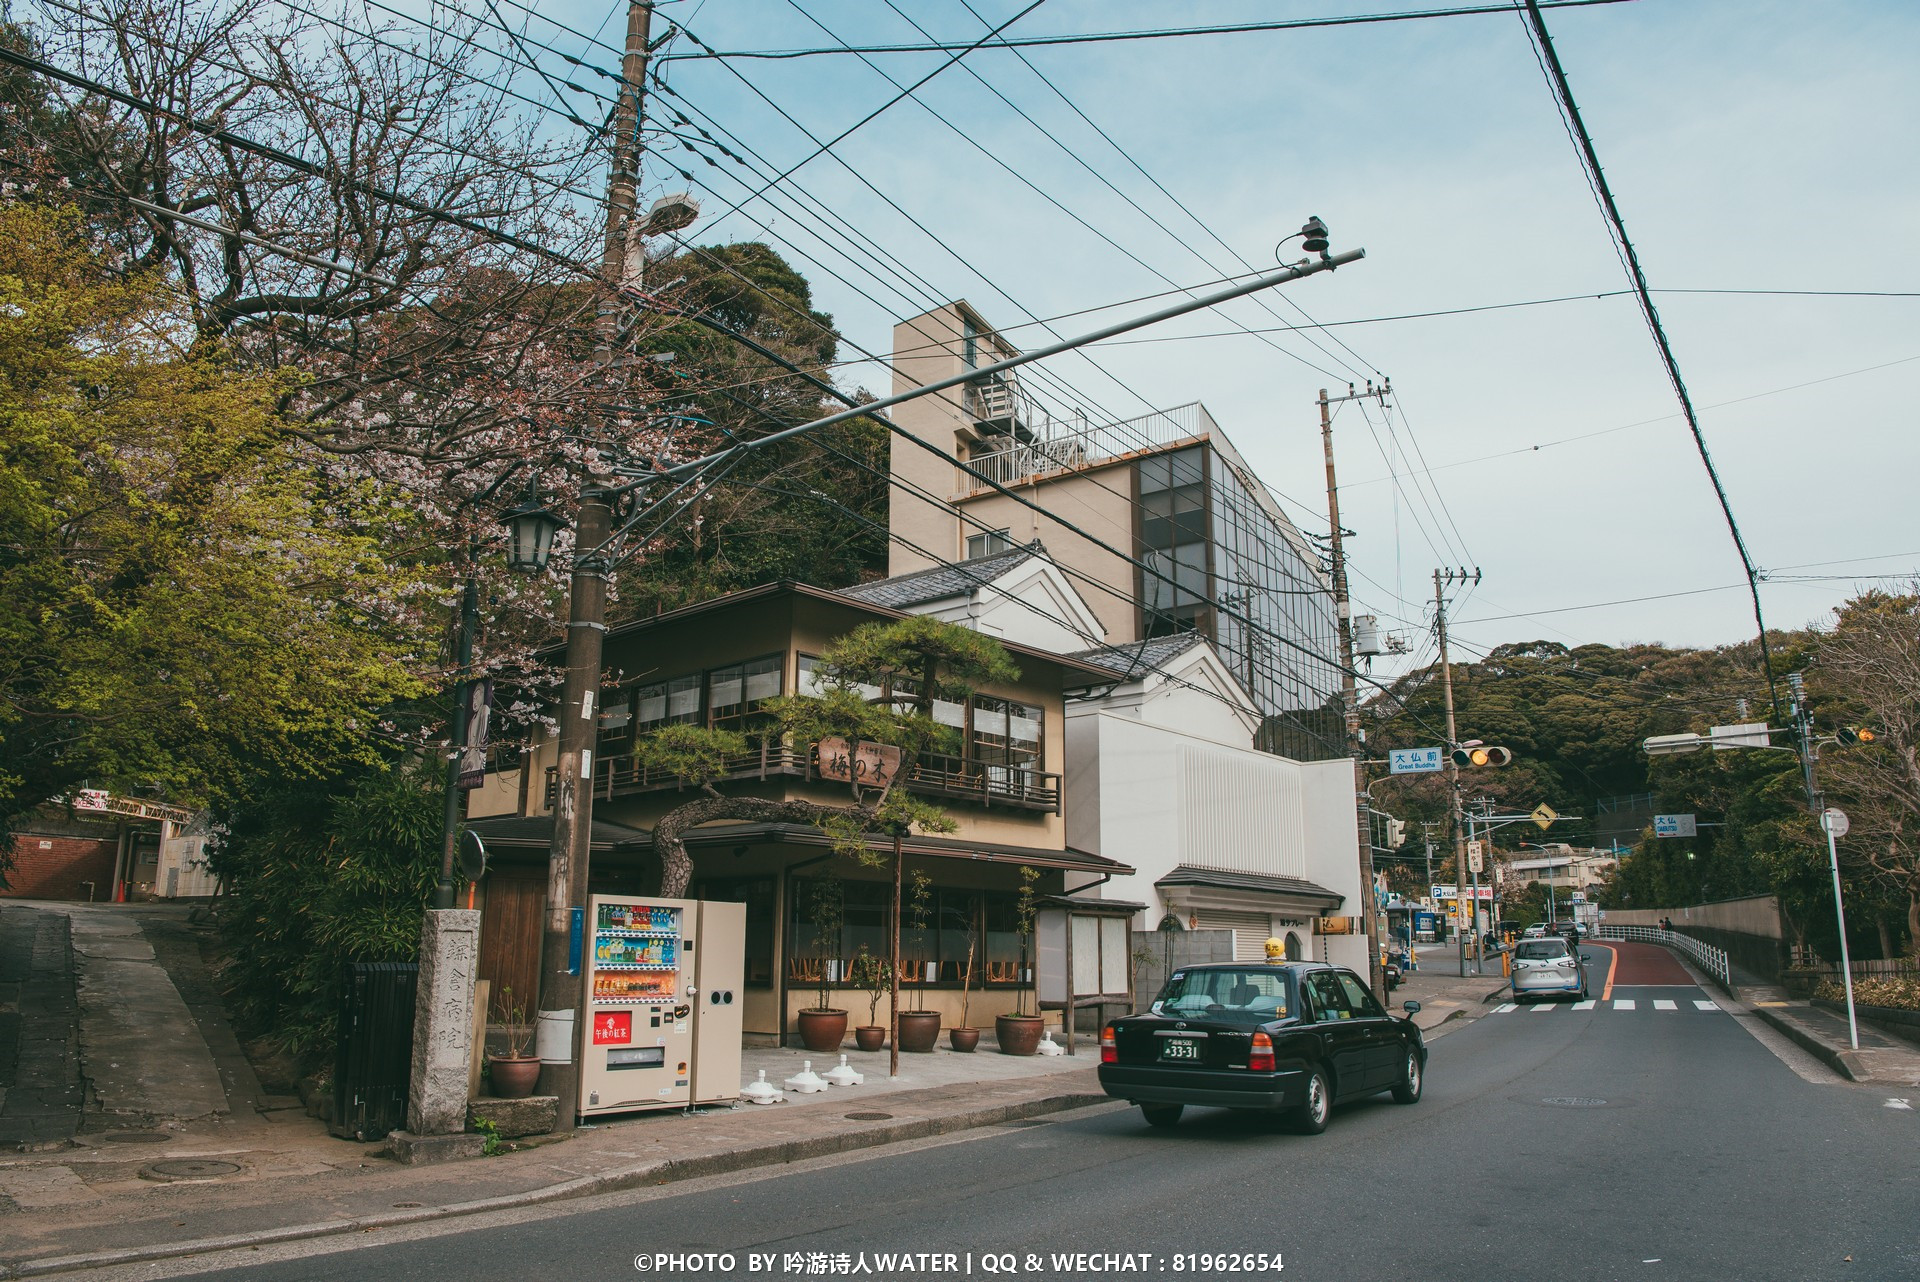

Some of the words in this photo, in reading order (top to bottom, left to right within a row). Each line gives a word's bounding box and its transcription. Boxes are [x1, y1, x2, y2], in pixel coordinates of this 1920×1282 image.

[1395, 751, 1437, 764] 大仏前
[1657, 816, 1677, 825] 大仏
[1276, 1006, 1287, 1014] 18
[595, 1028, 627, 1040] 午後の紅茶
[1170, 1045, 1197, 1058] 33-31
